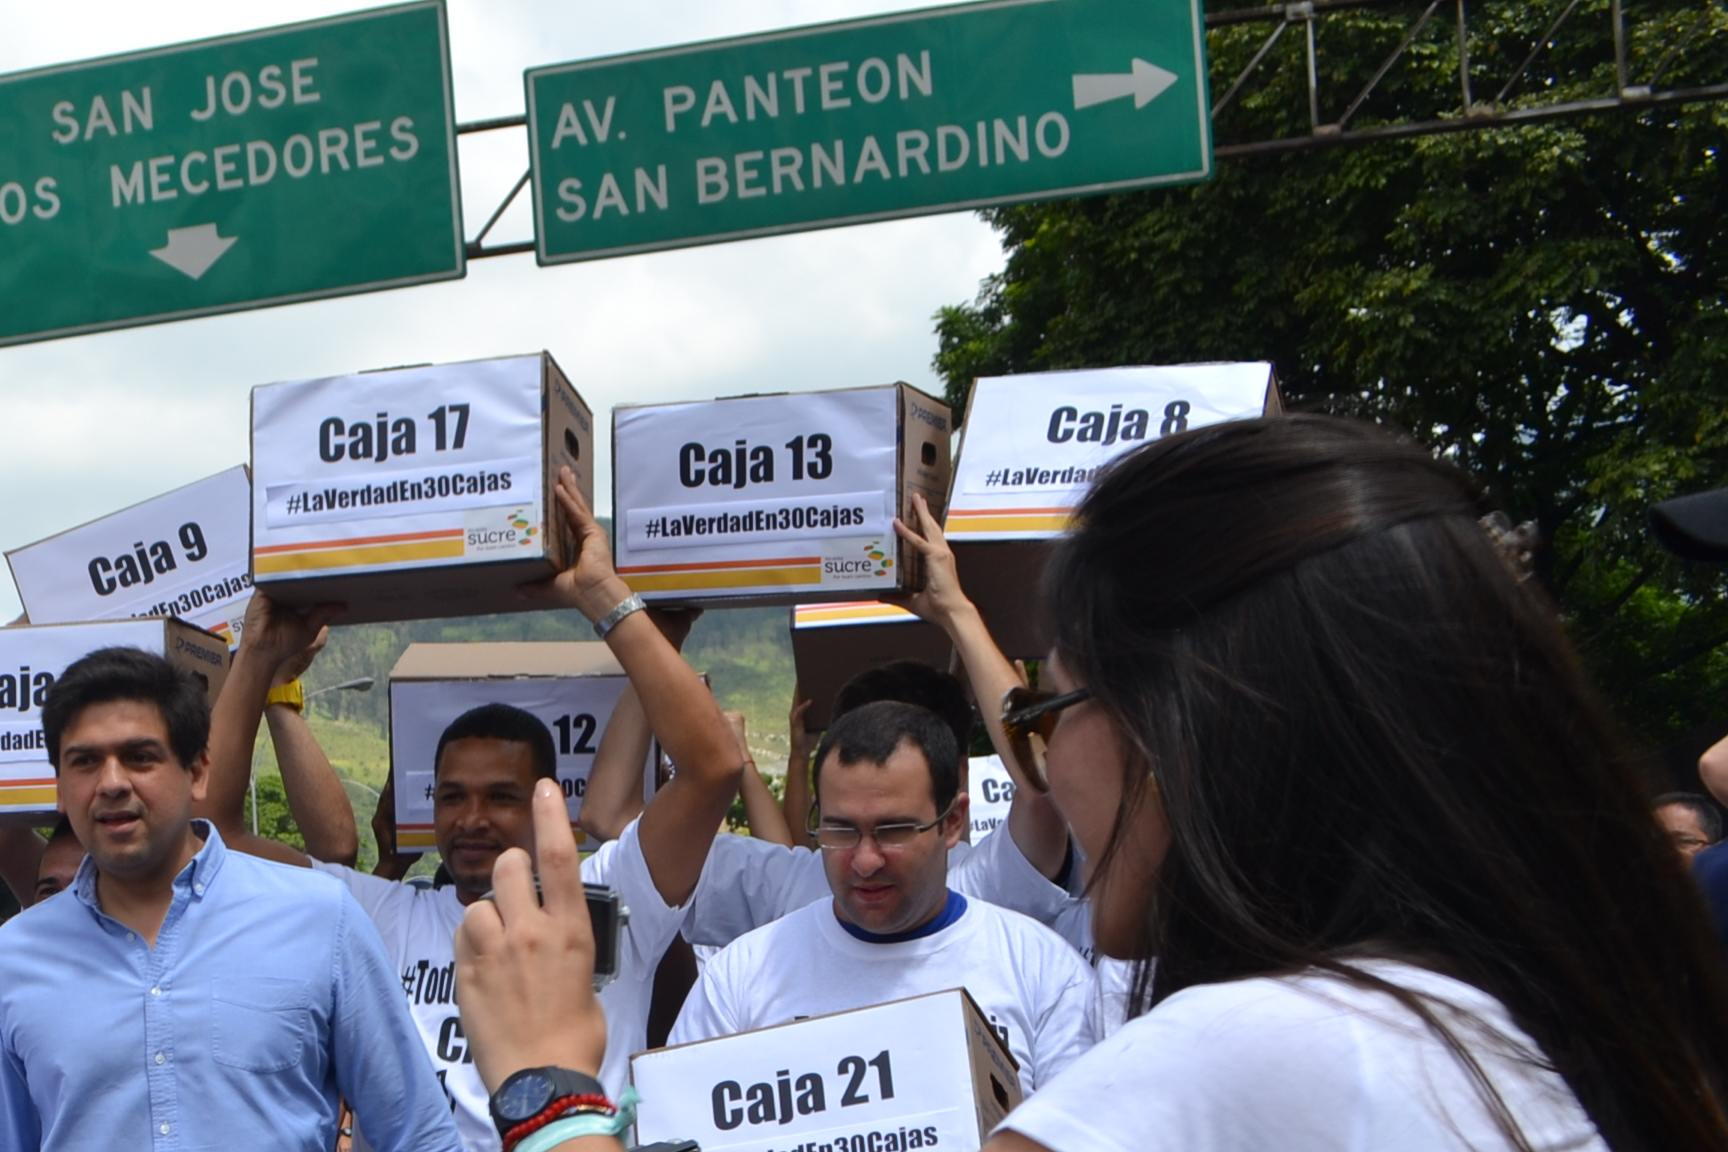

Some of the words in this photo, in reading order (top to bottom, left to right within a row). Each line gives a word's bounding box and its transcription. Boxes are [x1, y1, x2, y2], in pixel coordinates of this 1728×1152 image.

[51, 86, 155, 145] SAN
[189, 57, 322, 122] JOSE
[551, 96, 627, 149] AV.
[663, 50, 934, 132] PANTEON
[109, 115, 421, 208] MECEDORES
[555, 164, 671, 223] SAN
[696, 110, 1071, 205] BERNARDINO
[318, 411, 417, 464] Caja
[427, 402, 471, 452] 17
[1046, 403, 1150, 447] Caja
[1159, 399, 1191, 438] 8
[678, 439, 775, 490] Caja
[784, 432, 834, 481] 13
[286, 470, 513, 515] #LaVerdadEn30Cajas
[645, 504, 865, 539] #LaVerdadEn30Cajas
[87, 539, 177, 597] Caja
[177, 520, 209, 563] 9
[467, 528, 516, 546] sucre
[824, 559, 872, 574] sucre
[552, 713, 597, 755] 12
[710, 1068, 827, 1132] Caja
[836, 1048, 895, 1109] 21
